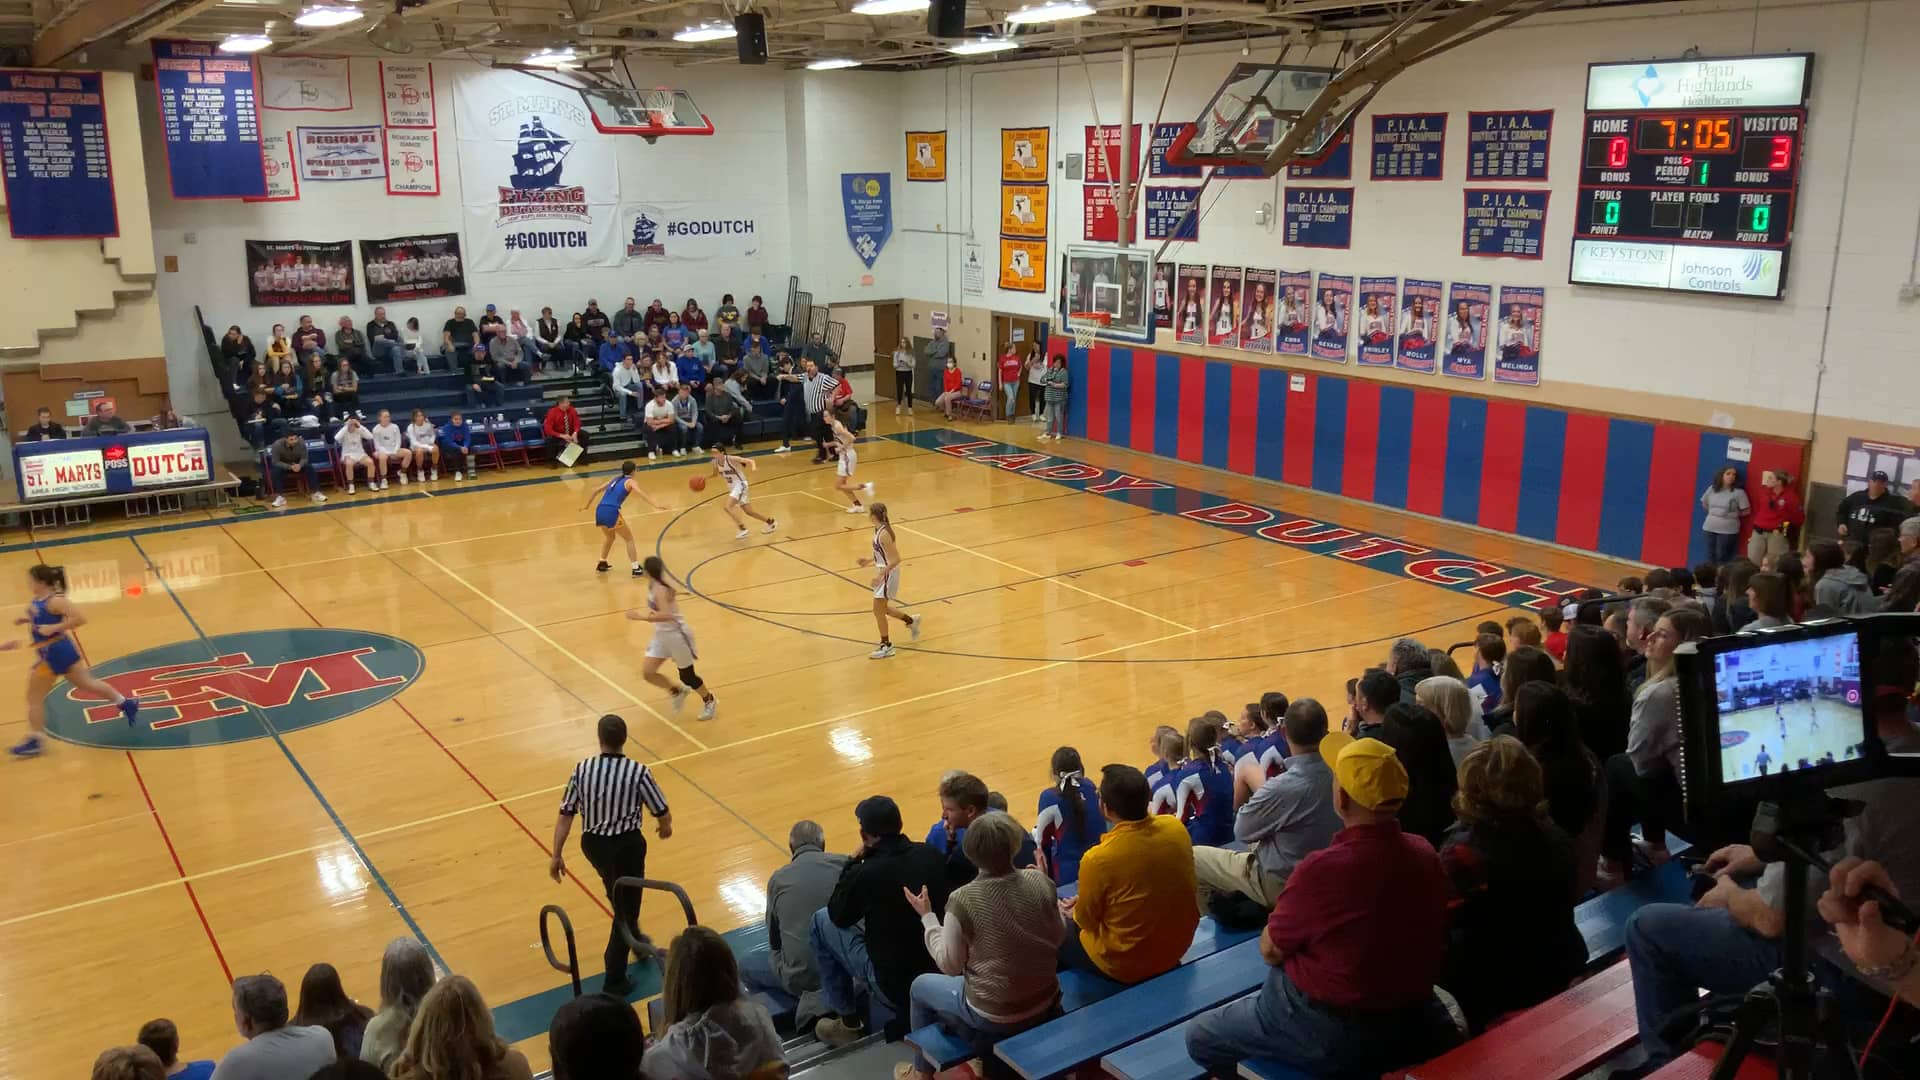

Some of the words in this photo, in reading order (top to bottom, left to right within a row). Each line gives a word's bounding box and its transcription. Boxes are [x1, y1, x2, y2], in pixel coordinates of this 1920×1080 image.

[1696, 62, 1735, 78] Penn
[1677, 76, 1753, 94] Highlands
[1682, 94, 1743, 106] Healthcare
[515, 95, 586, 126] MARYS
[1593, 120, 1628, 133] HOME
[1743, 117, 1798, 132] VISITOR
[1660, 120, 1730, 148] 7:05
[1610, 137, 1628, 167] 0
[1770, 136, 1791, 169] 3
[1600, 172, 1630, 182] BONUS
[1655, 165, 1690, 176] PERIOD
[1700, 162, 1708, 185] 1
[1735, 172, 1769, 182] BONUS
[500, 187, 584, 204] FLYING
[1594, 190, 1622, 200] FOULS
[1650, 192, 1684, 202] PLAYER
[1689, 193, 1720, 203] FOULS
[1740, 194, 1772, 205] FOULS
[1605, 201, 1620, 224] 0
[1752, 206, 1770, 231] 0
[666, 220, 754, 237] #GODUTCH
[1590, 225, 1618, 235] POINTS
[1682, 230, 1712, 240] MATCH
[504, 231, 588, 250] #GODUTCH
[1736, 232, 1769, 242] POINTS
[1590, 246, 1666, 262] KEYSTONE
[1681, 262, 1732, 277] Johnson
[1689, 276, 1741, 292] Controls
[1406, 351, 1427, 359] MOLLY
[1501, 362, 1533, 371] MELINDA
[105, 458, 128, 470] POSS
[132, 454, 204, 477] DUTCH
[54, 462, 102, 484] MARYS
[938, 441, 1172, 492] LADY
[1183, 502, 1592, 608] DUTCH
